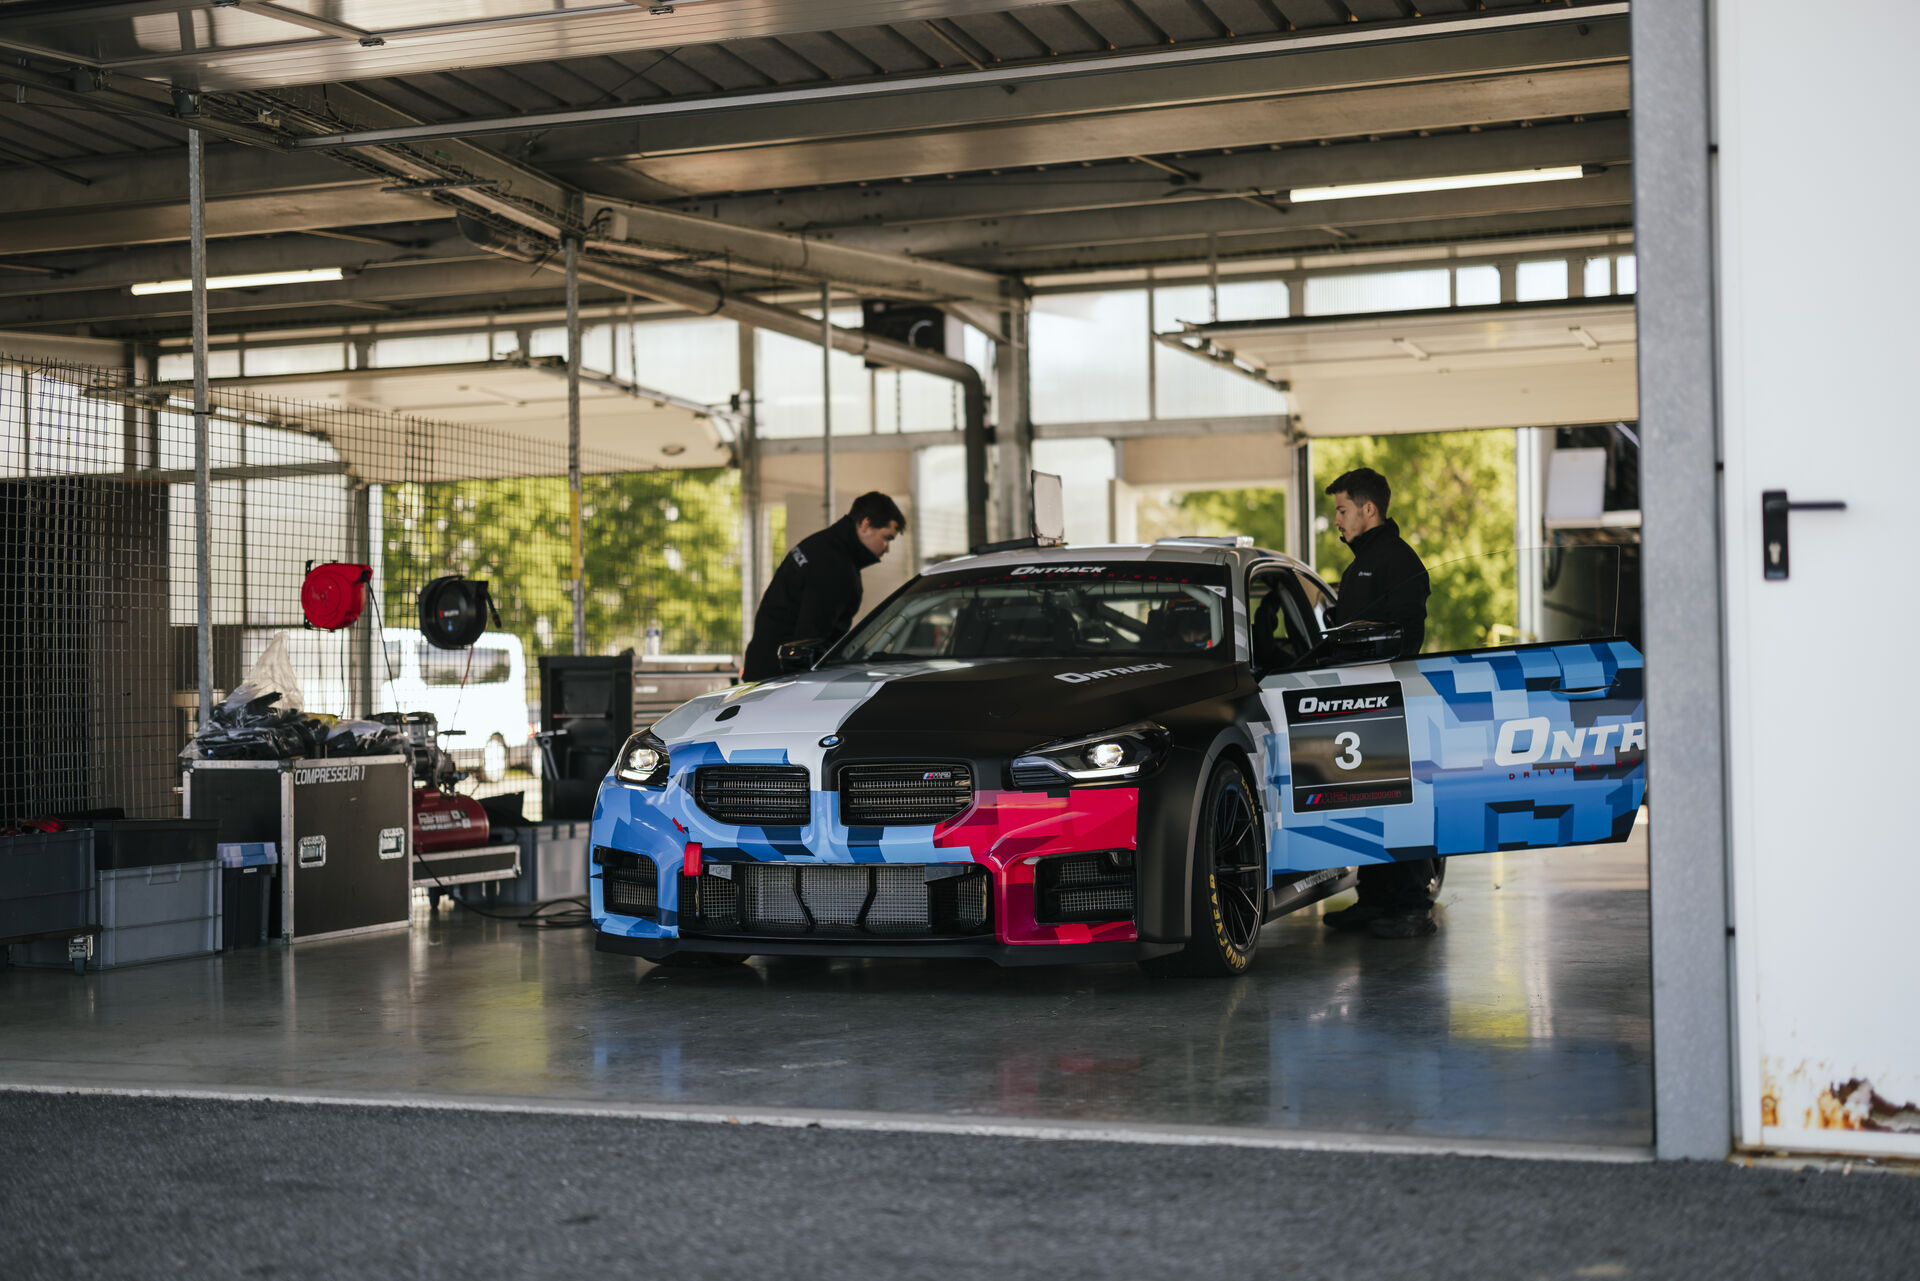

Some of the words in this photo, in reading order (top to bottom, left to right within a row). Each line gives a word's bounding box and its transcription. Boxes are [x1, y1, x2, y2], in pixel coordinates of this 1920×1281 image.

[1298, 696, 1390, 714] ONTRACK
[1334, 731, 1363, 771] 3
[1494, 716, 1647, 767] ONTR
[294, 765, 360, 786] COMPRESSEUR
[361, 765, 366, 781] 1
[1508, 764, 1598, 781] DRIVING
[1208, 873, 1247, 969] GOODYEAR
